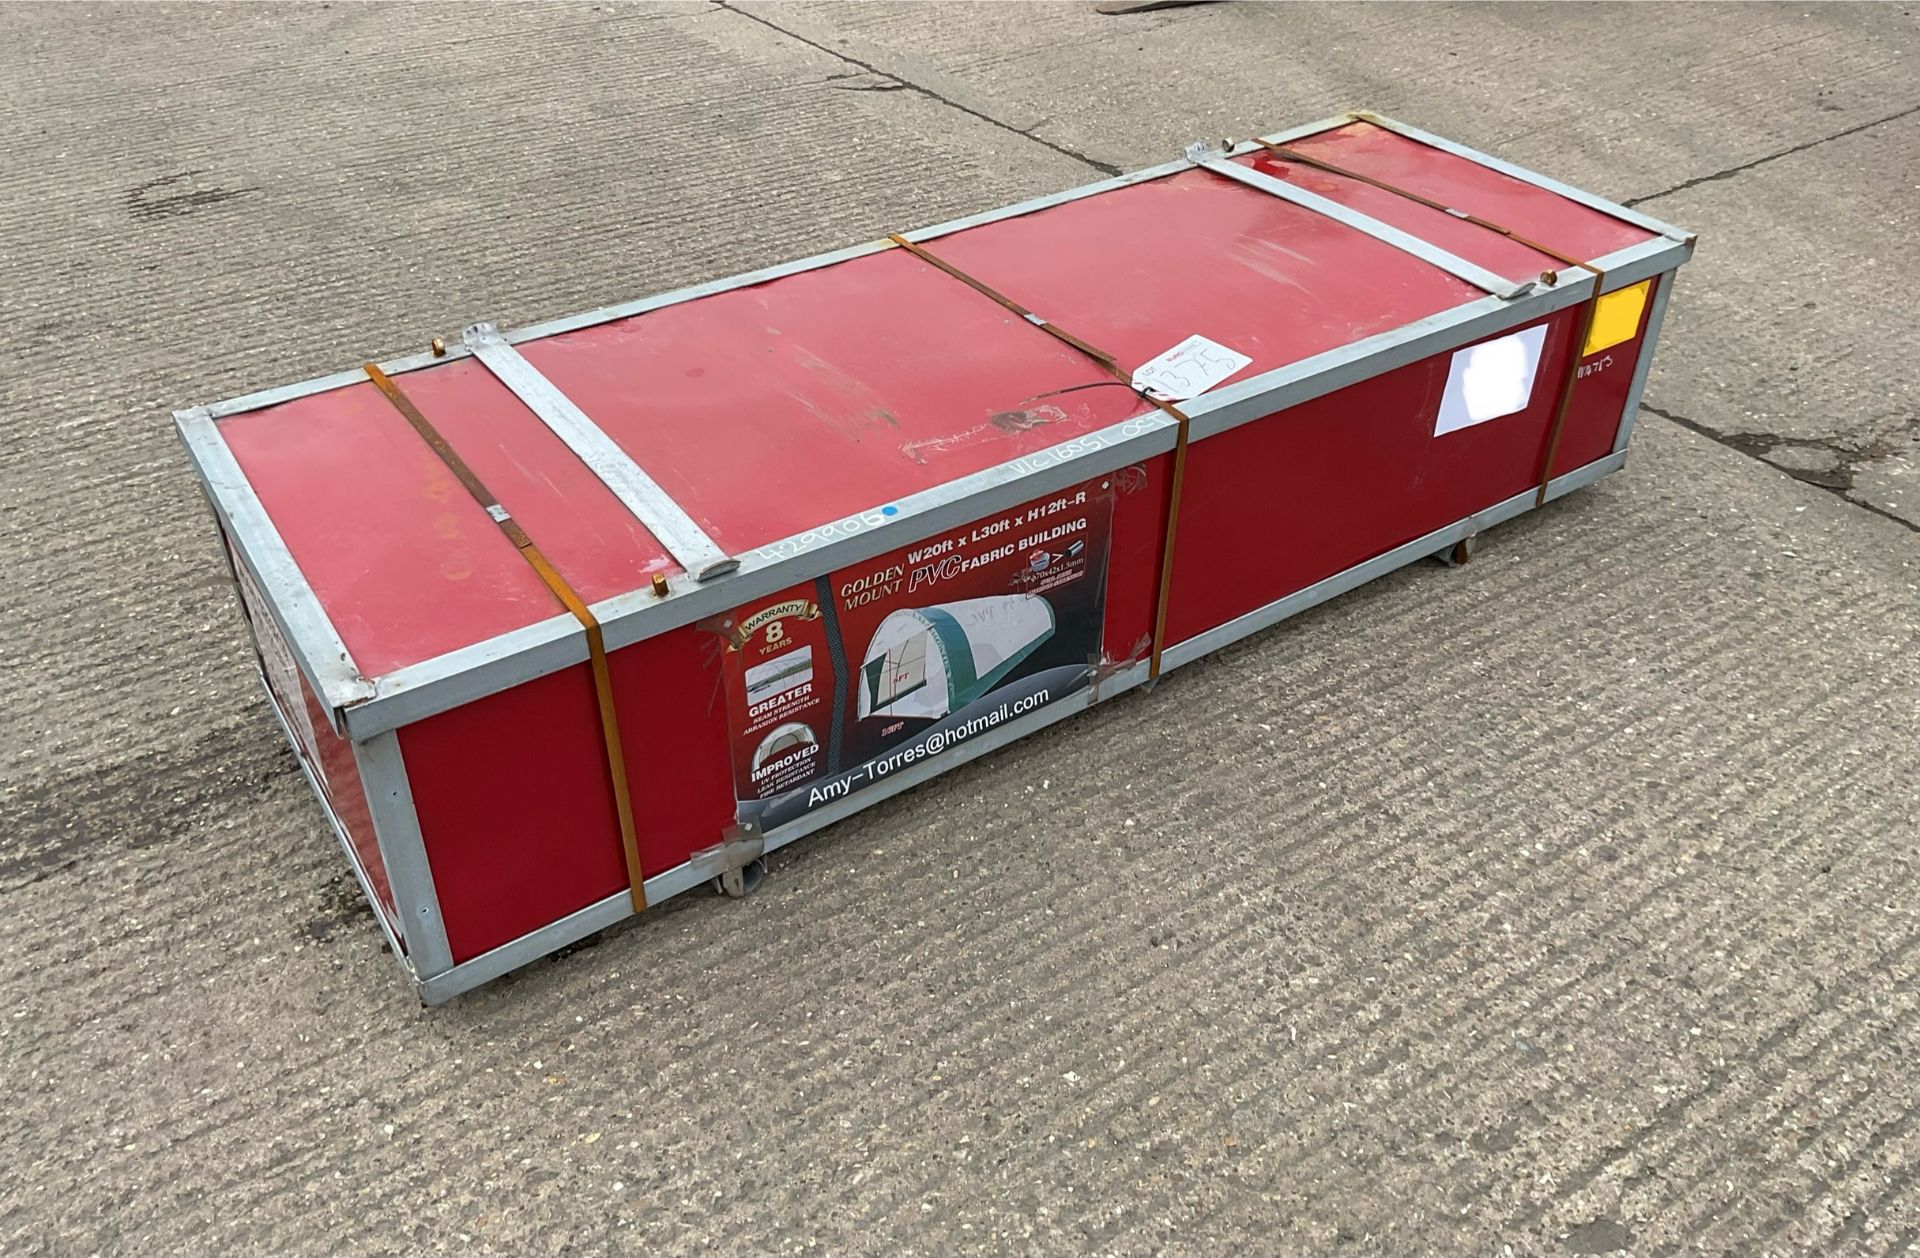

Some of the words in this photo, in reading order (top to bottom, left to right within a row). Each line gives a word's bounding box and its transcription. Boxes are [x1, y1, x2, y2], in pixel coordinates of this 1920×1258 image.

[907, 540, 953, 565] W20ft
[958, 535, 967, 547] x
[971, 521, 1010, 542] L30ft
[1014, 517, 1024, 527] x
[1027, 491, 1086, 522] H12ft-R
[908, 555, 962, 593] PVC
[961, 544, 1015, 573] FABRIC
[1018, 518, 1087, 551] BUILDING
[840, 564, 905, 597] GOLDEN
[843, 579, 904, 612] MOUNT
[745, 604, 802, 630] WARRANTY
[766, 620, 784, 643] 8
[759, 637, 792, 655] YEARS
[743, 717, 777, 736] ABRASION
[779, 697, 821, 720] RESISTANCE
[749, 683, 812, 717] GREATER
[752, 744, 819, 782] IMPROVED
[808, 688, 1049, 808] Amy-Torres@hotmail.com
[771, 757, 812, 780] PROTECTION
[776, 761, 816, 783] RESISTANCE
[776, 768, 815, 792] RETARDANT
